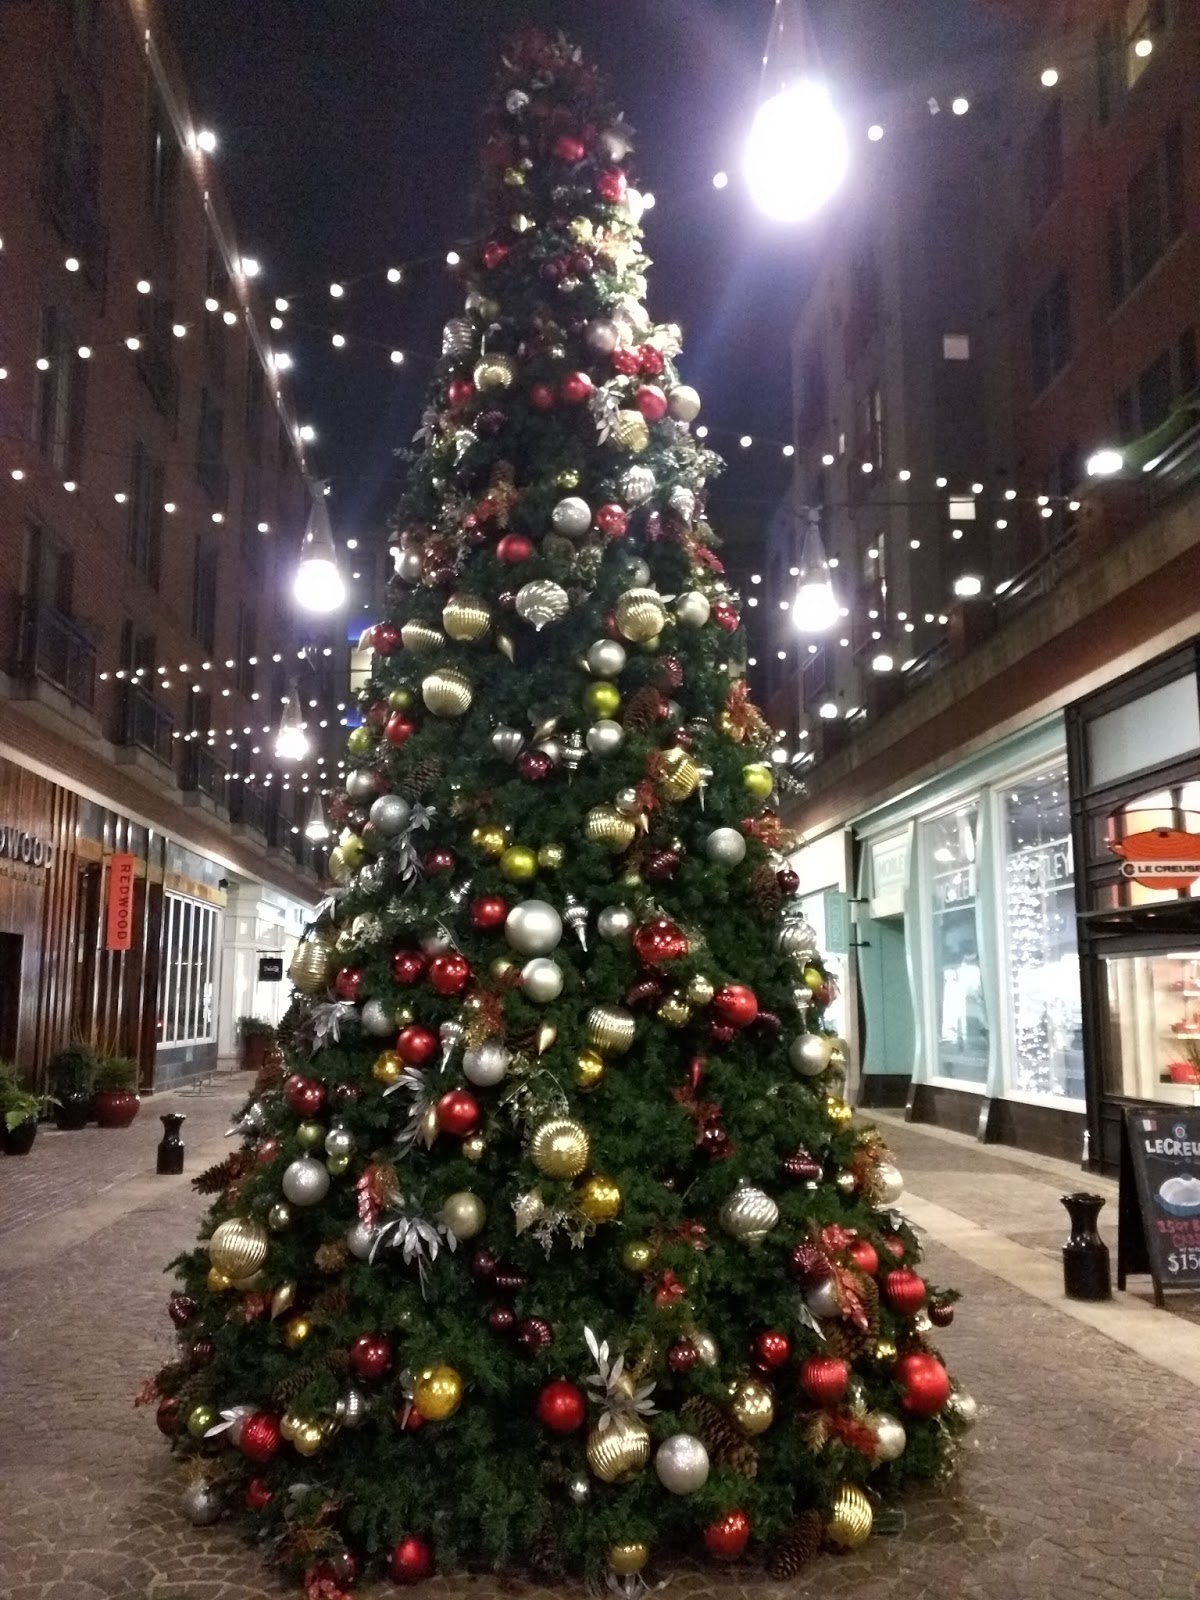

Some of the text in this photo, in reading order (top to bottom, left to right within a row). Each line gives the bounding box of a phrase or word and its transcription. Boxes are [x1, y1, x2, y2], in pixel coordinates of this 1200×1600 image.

[1138, 865, 1153, 873] LE
[117, 864, 131, 940] REDWOOD
[1167, 1253, 1200, 1275] $15
